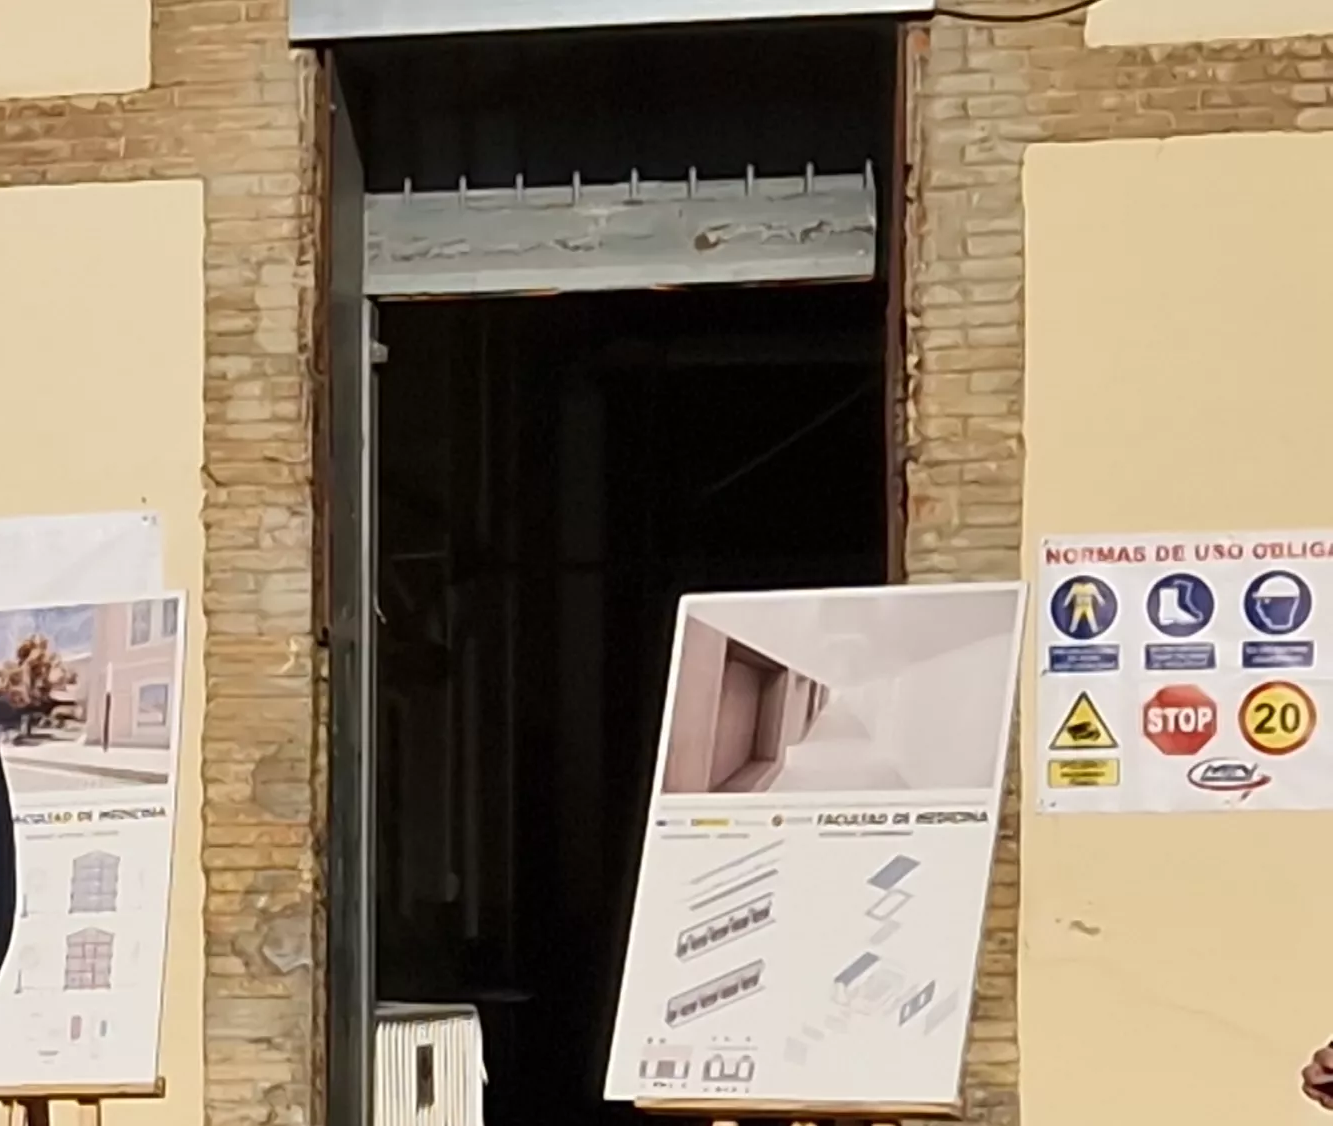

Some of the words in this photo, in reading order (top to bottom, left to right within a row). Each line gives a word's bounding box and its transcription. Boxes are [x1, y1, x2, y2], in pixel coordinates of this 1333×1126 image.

[1045, 545, 1146, 564] NORMAS
[1155, 545, 1186, 562] DE
[1195, 543, 1243, 561] USO
[1147, 706, 1212, 734] STOP
[1253, 703, 1301, 734] 20
[12, 811, 73, 826] ACULTAD
